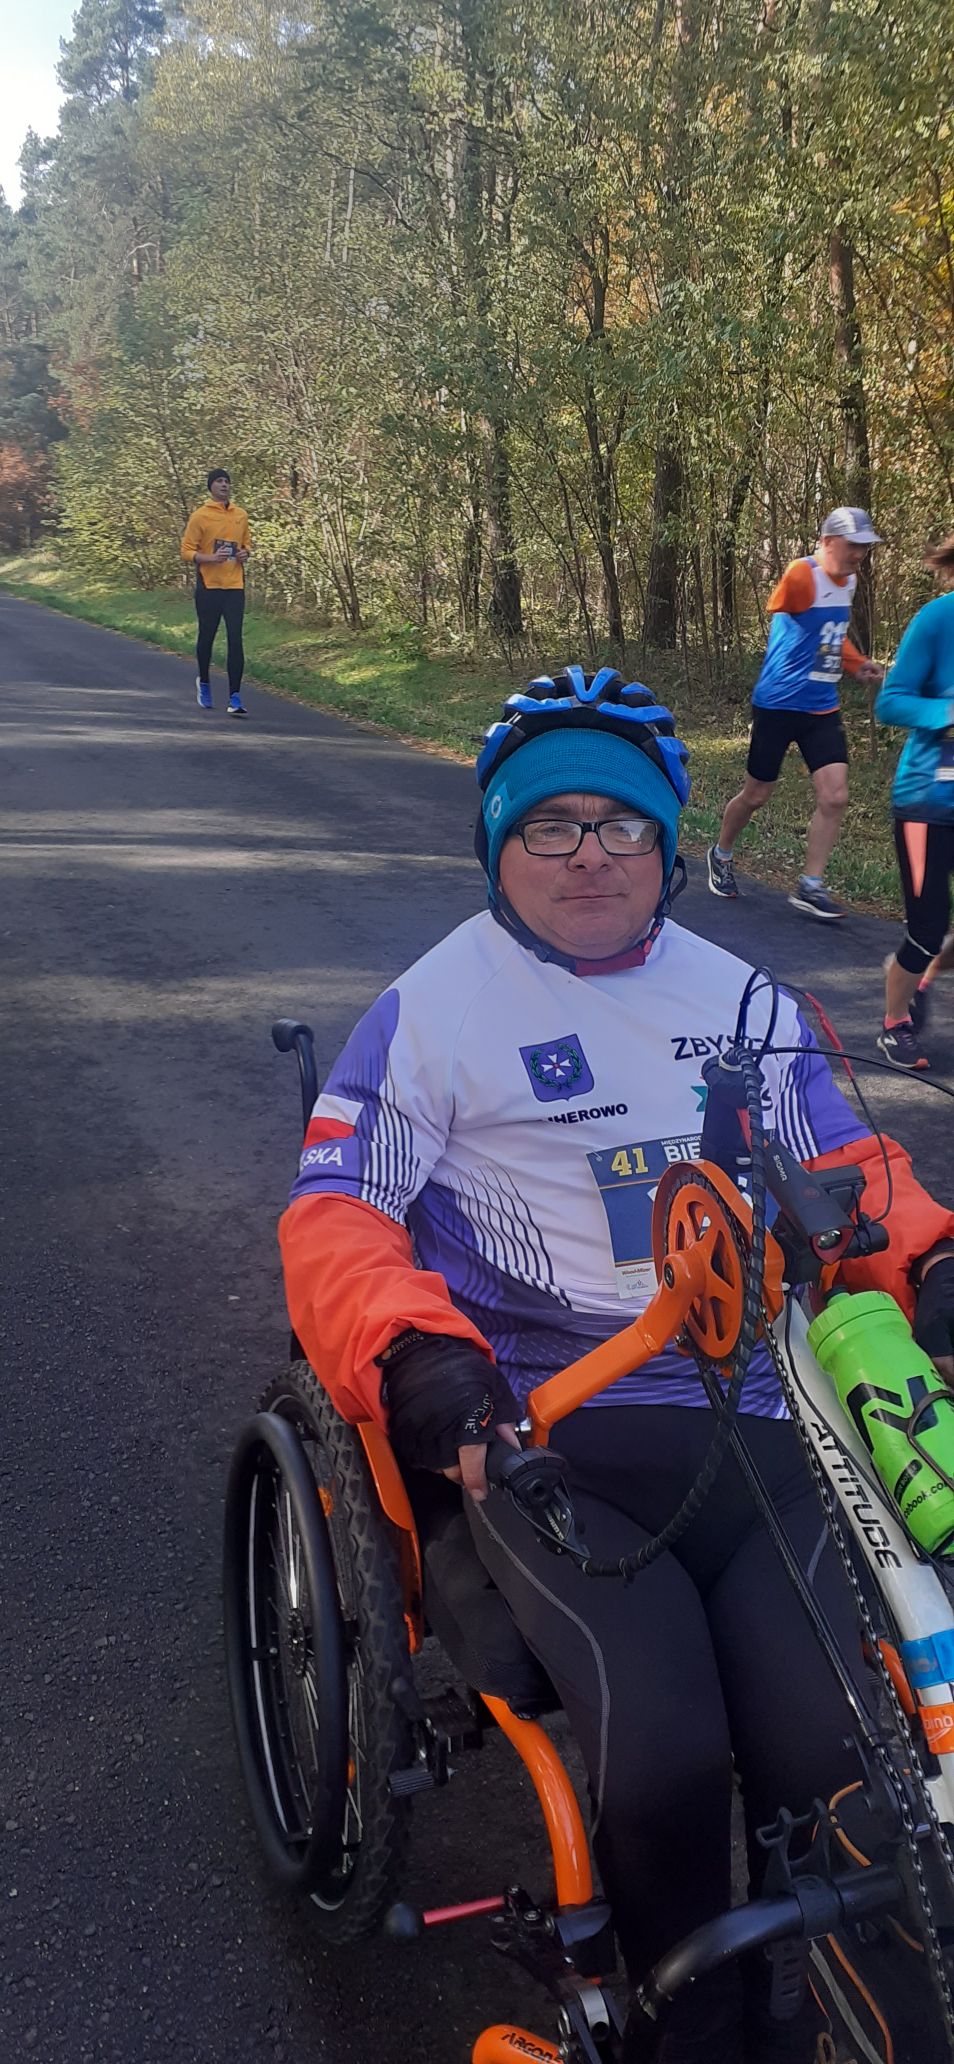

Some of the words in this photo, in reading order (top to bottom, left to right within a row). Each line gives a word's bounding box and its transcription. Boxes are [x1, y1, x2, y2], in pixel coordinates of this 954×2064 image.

[300, 1146, 343, 1171] SKA
[611, 1147, 648, 1176] 41
[773, 1154, 788, 1182] SIGMA
[810, 1422, 903, 1569] ATTITUDE
